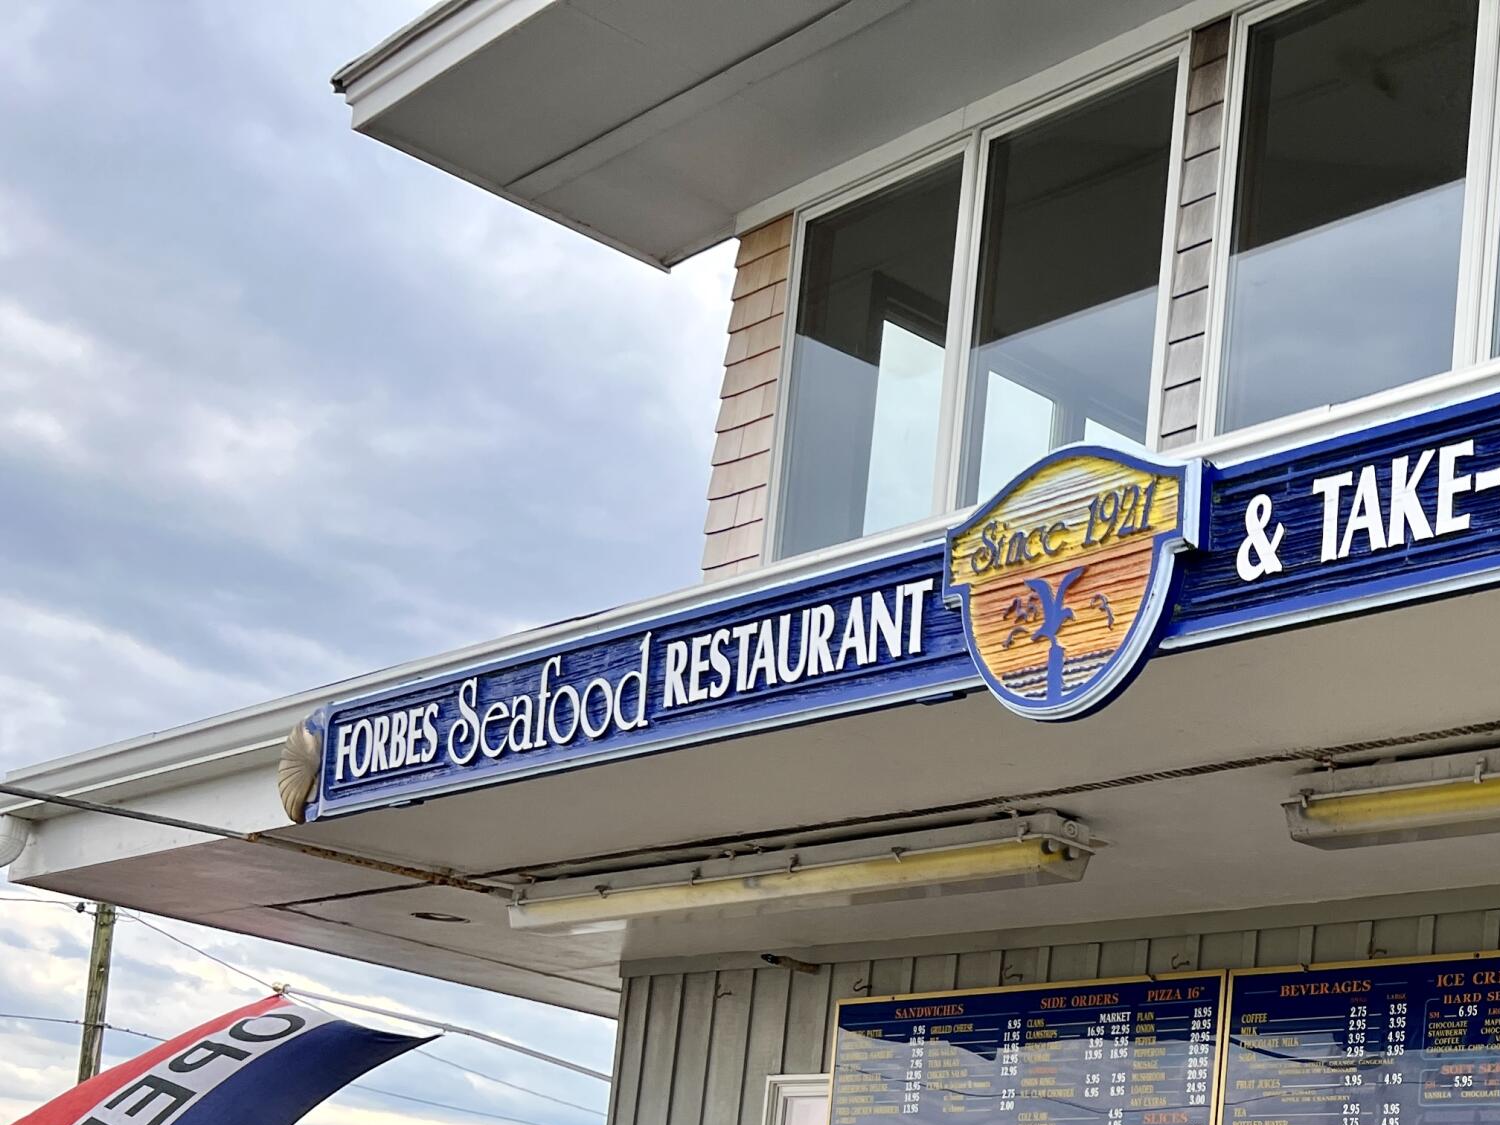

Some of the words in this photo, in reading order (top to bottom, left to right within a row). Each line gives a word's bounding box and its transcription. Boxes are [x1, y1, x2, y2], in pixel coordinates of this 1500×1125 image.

[971, 519, 1069, 574] Since
[1081, 475, 1157, 548] 1921
[1235, 492, 1284, 582] &
[335, 702, 439, 782] FORBES
[447, 631, 652, 766] Seafood
[663, 578, 934, 710] RESTAURANT
[1436, 973, 1465, 987] ICE
[1147, 989, 1181, 1002] PIZZA
[1280, 980, 1372, 997] BEVERAGES
[1041, 998, 1066, 1009] SIDE
[1072, 993, 1119, 1007] ORDERS
[1444, 993, 1481, 1004] HARD
[895, 1004, 964, 1019] SANDWICHES
[1100, 1012, 1131, 1022] MARKET
[1350, 1006, 1366, 1017] 2.75
[1389, 1003, 1407, 1014] 3.95
[1458, 1005, 1477, 1017] 6.95
[1144, 1112, 1188, 1124] SLICES
